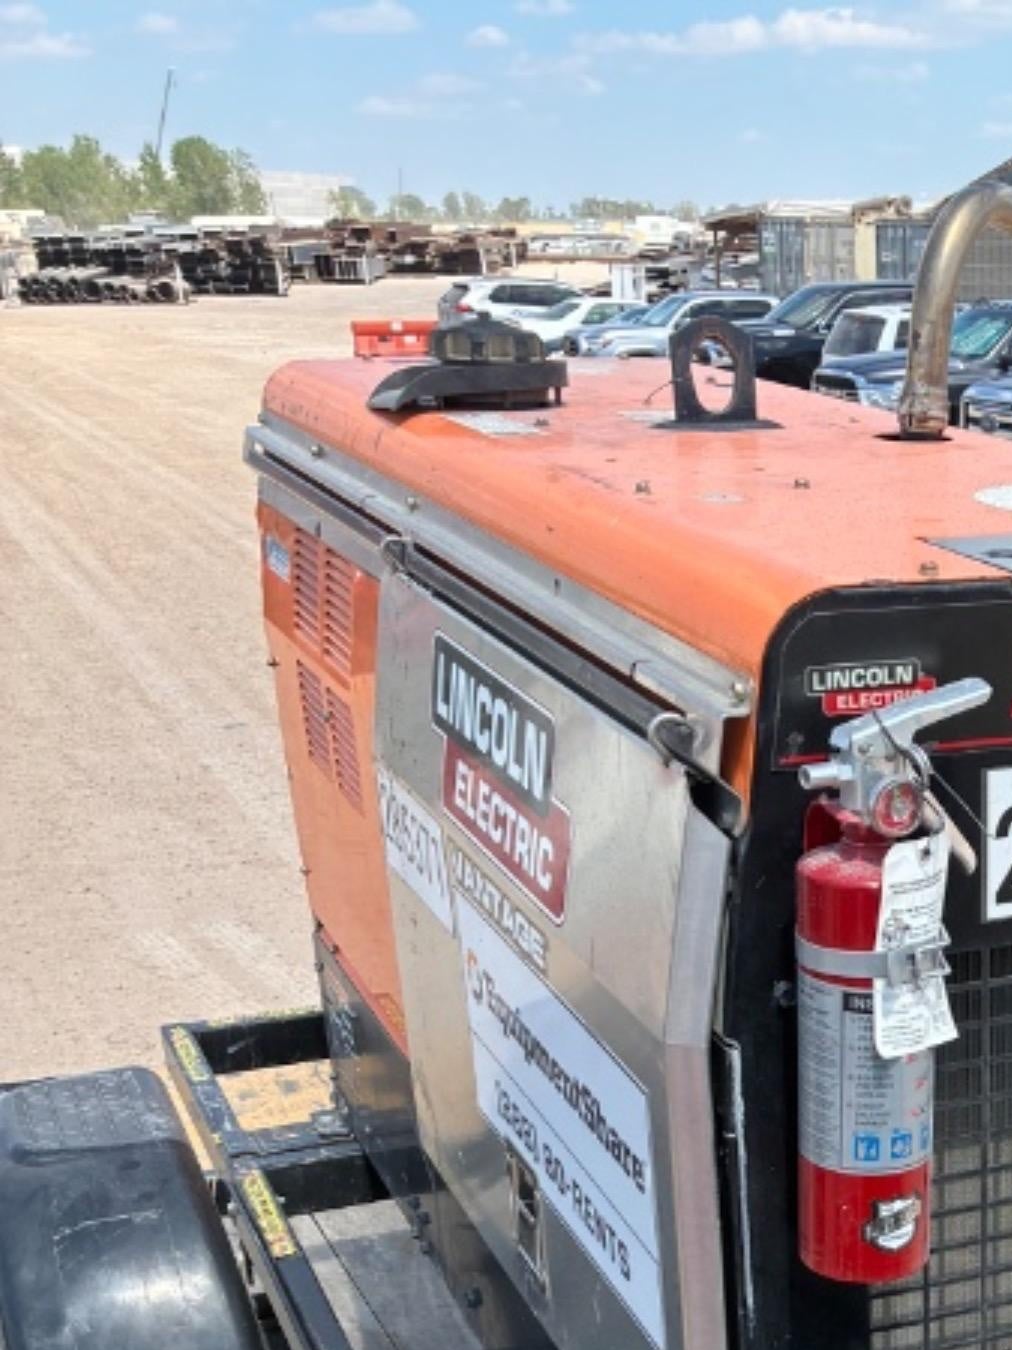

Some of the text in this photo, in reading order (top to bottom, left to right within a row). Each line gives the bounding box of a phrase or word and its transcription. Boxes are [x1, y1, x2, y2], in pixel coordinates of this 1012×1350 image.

[436, 652, 547, 801] LINCOLN
[811, 664, 914, 691] LINCOLN
[454, 759, 554, 892] ELECTRIC
[482, 968, 647, 1196] EquipmentShare
[543, 1141, 632, 1282] 80-RENTS
